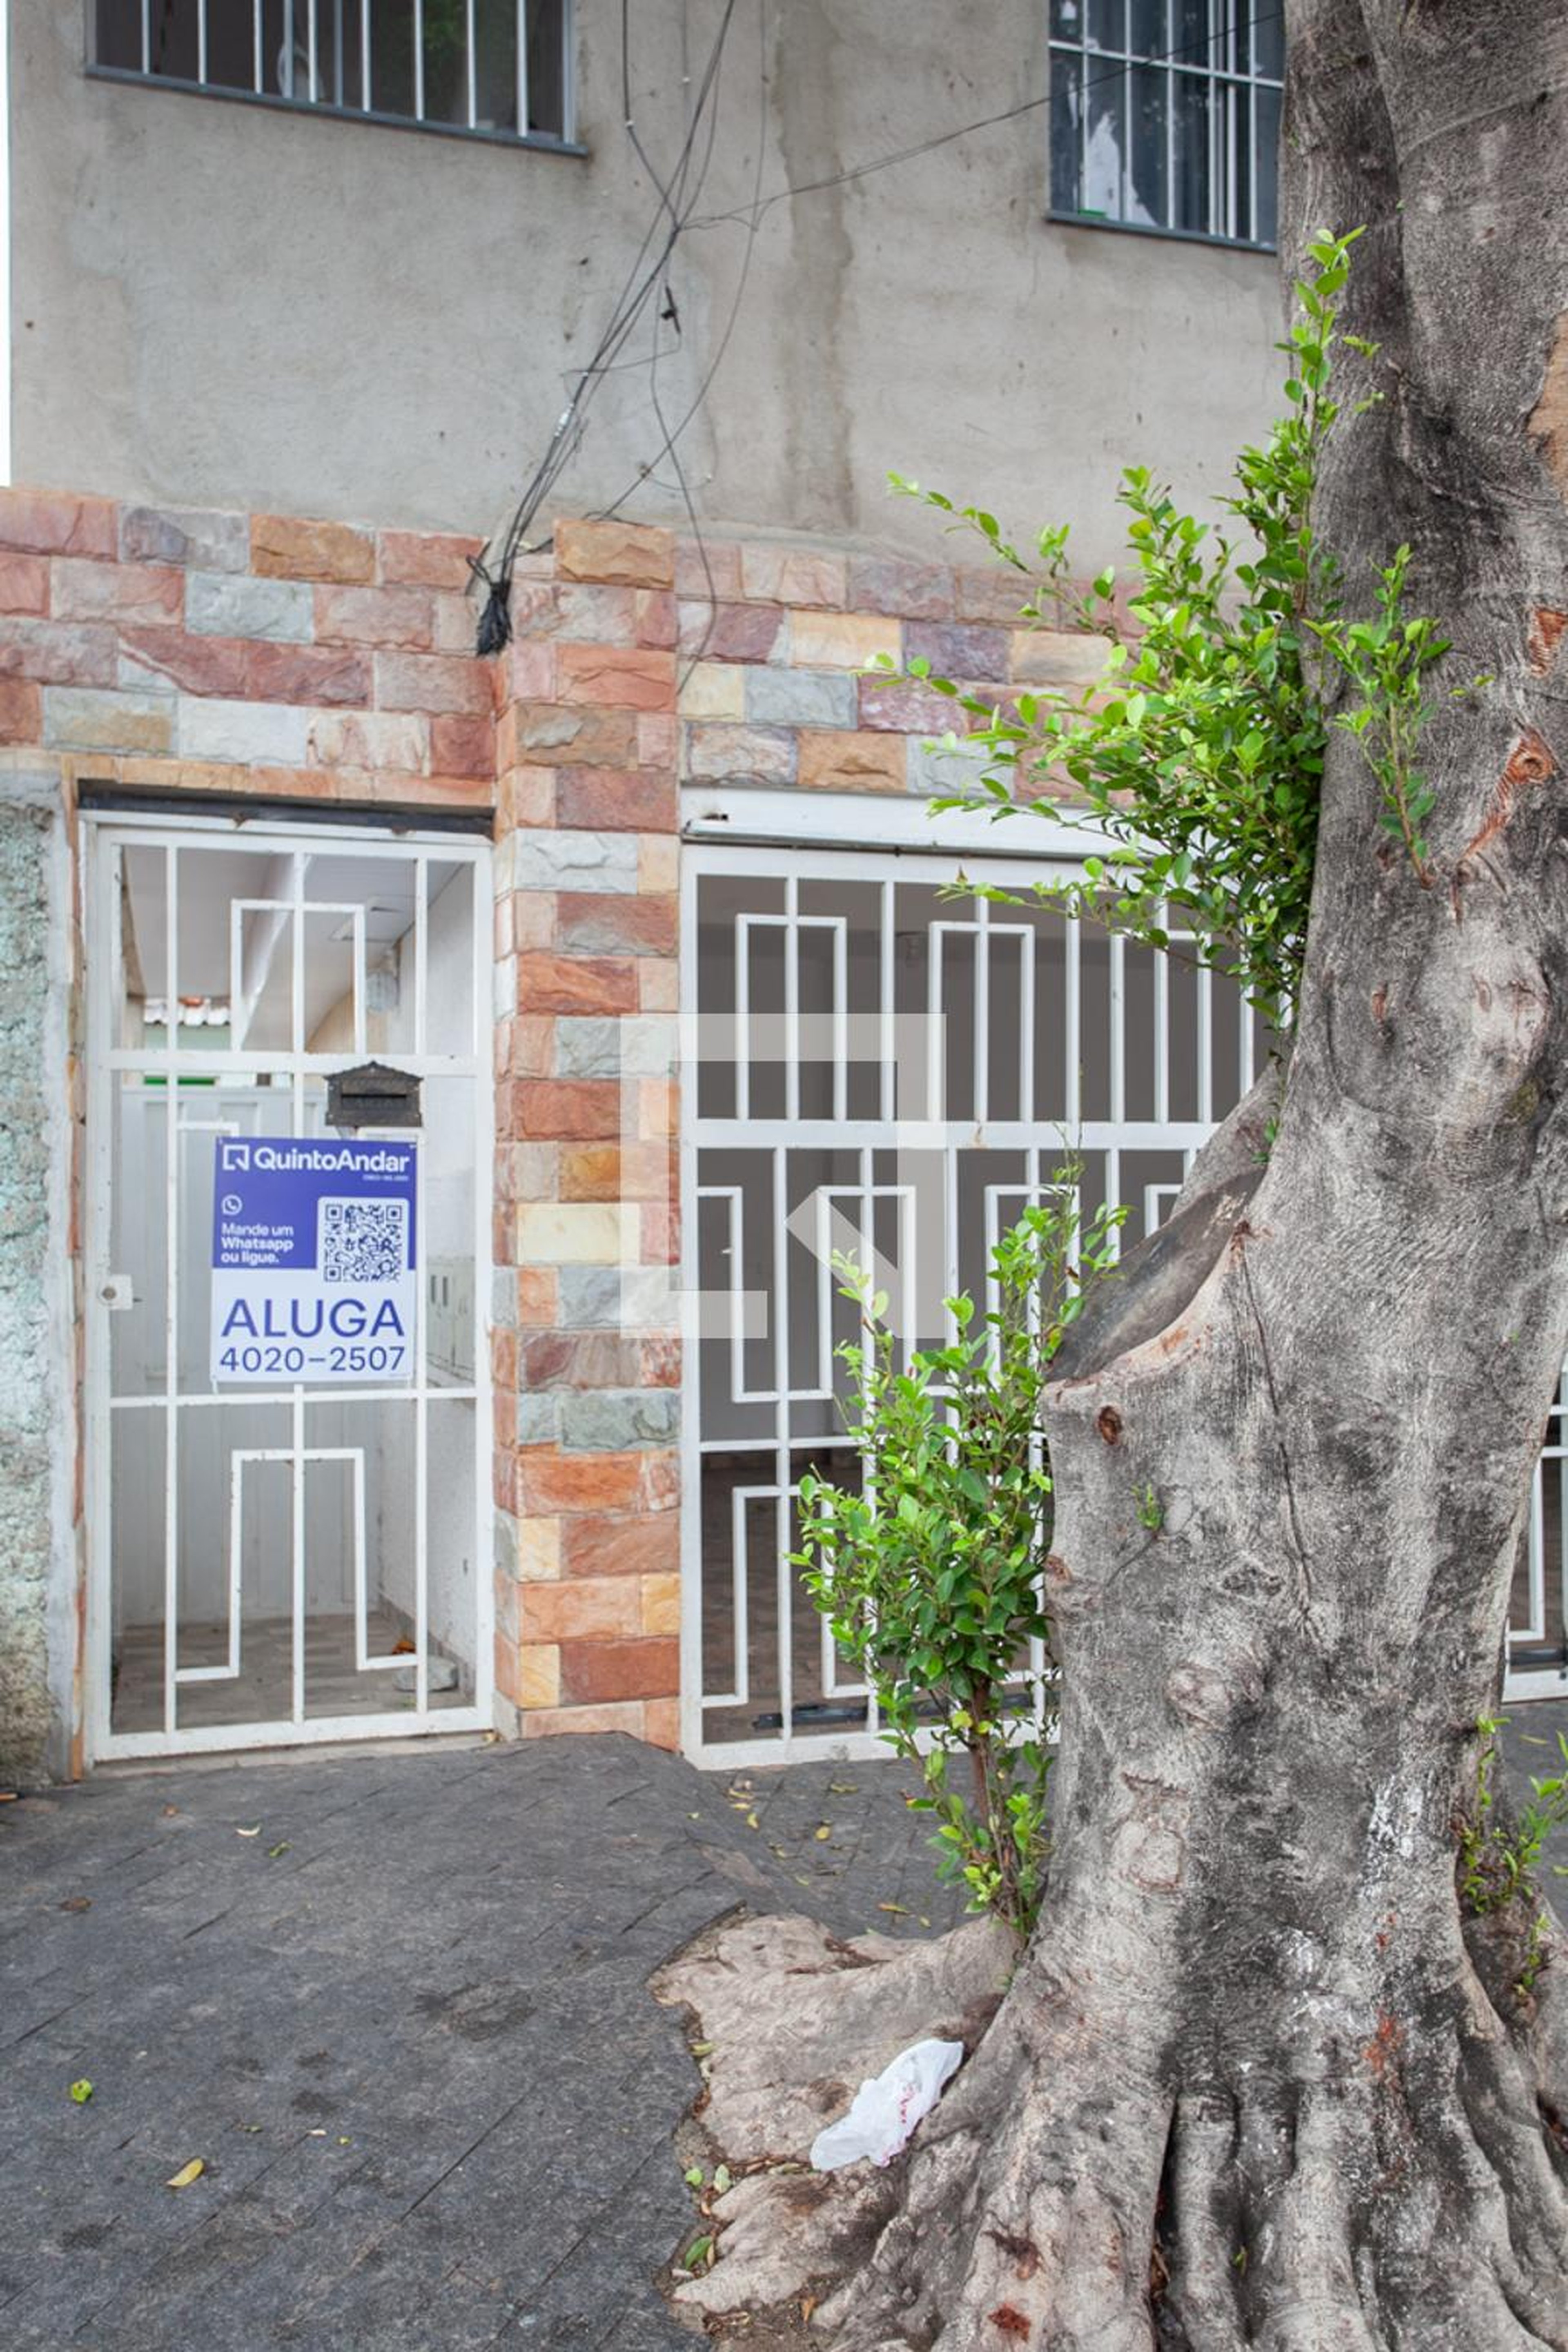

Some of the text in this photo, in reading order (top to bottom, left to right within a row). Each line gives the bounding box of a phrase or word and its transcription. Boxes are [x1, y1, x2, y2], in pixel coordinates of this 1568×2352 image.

[254, 1147, 409, 1171] QuintoAndar
[222, 1223, 294, 1236] Mande um
[221, 1236, 294, 1252] Whatsapp
[221, 1250, 279, 1265] ou ligue.
[220, 1299, 404, 1337] ALUGA
[220, 1346, 405, 1372] 4020-2507
